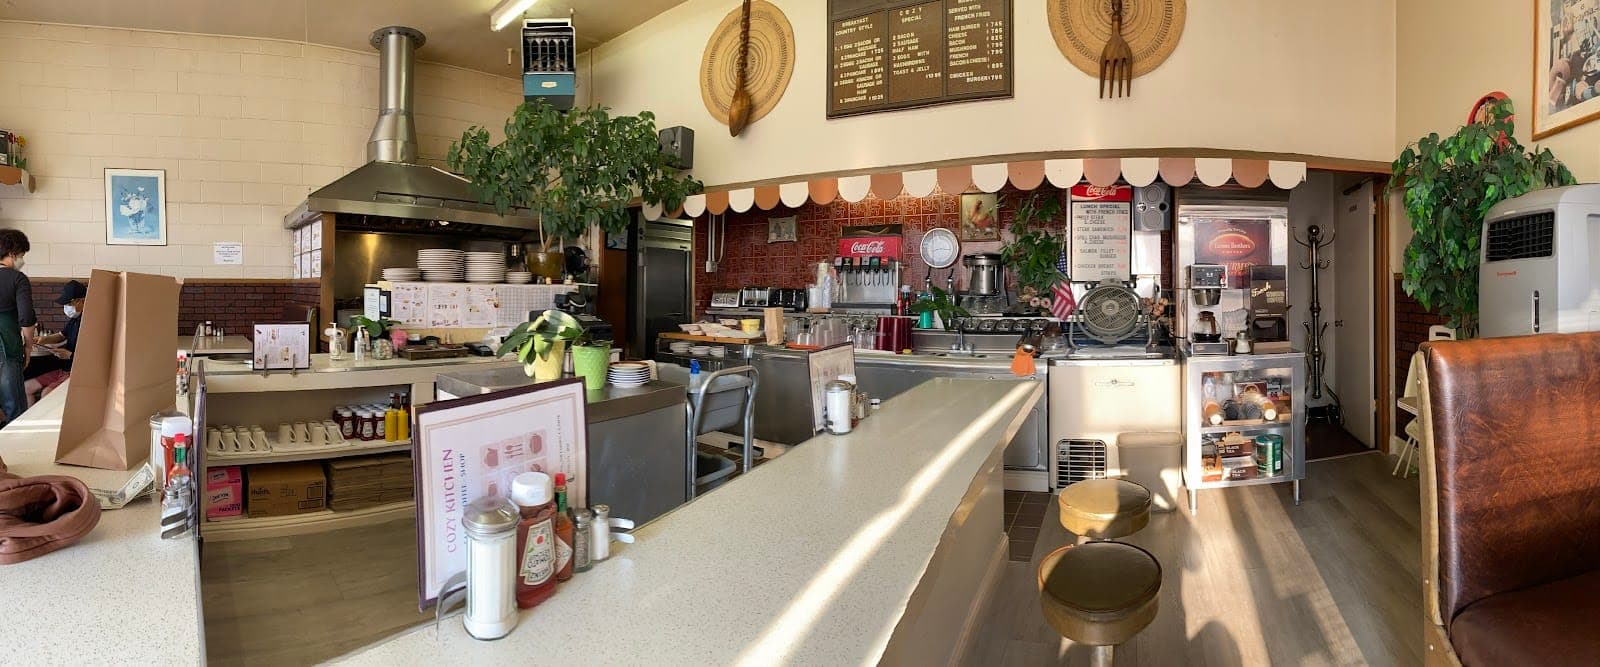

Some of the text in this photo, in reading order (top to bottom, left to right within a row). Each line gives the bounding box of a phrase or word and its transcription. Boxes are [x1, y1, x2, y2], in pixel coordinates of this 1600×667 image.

[948, 6, 968, 14] SERVED
[901, 14, 922, 23] SPECIAL
[954, 13, 976, 21] FRENCH
[835, 23, 873, 36] COUNTRY STYLE
[897, 32, 915, 40] BACON
[948, 31, 967, 39] CHEESE
[897, 37, 919, 46] SAUSAGE
[949, 44, 977, 53] MUSHROOM
[893, 68, 909, 76] TOAST
[916, 65, 930, 73] JELLY
[949, 71, 974, 79] CHICKEN
[851, 240, 885, 254] Coca-Cola
[442, 448, 457, 553] COZY KITCHEN
